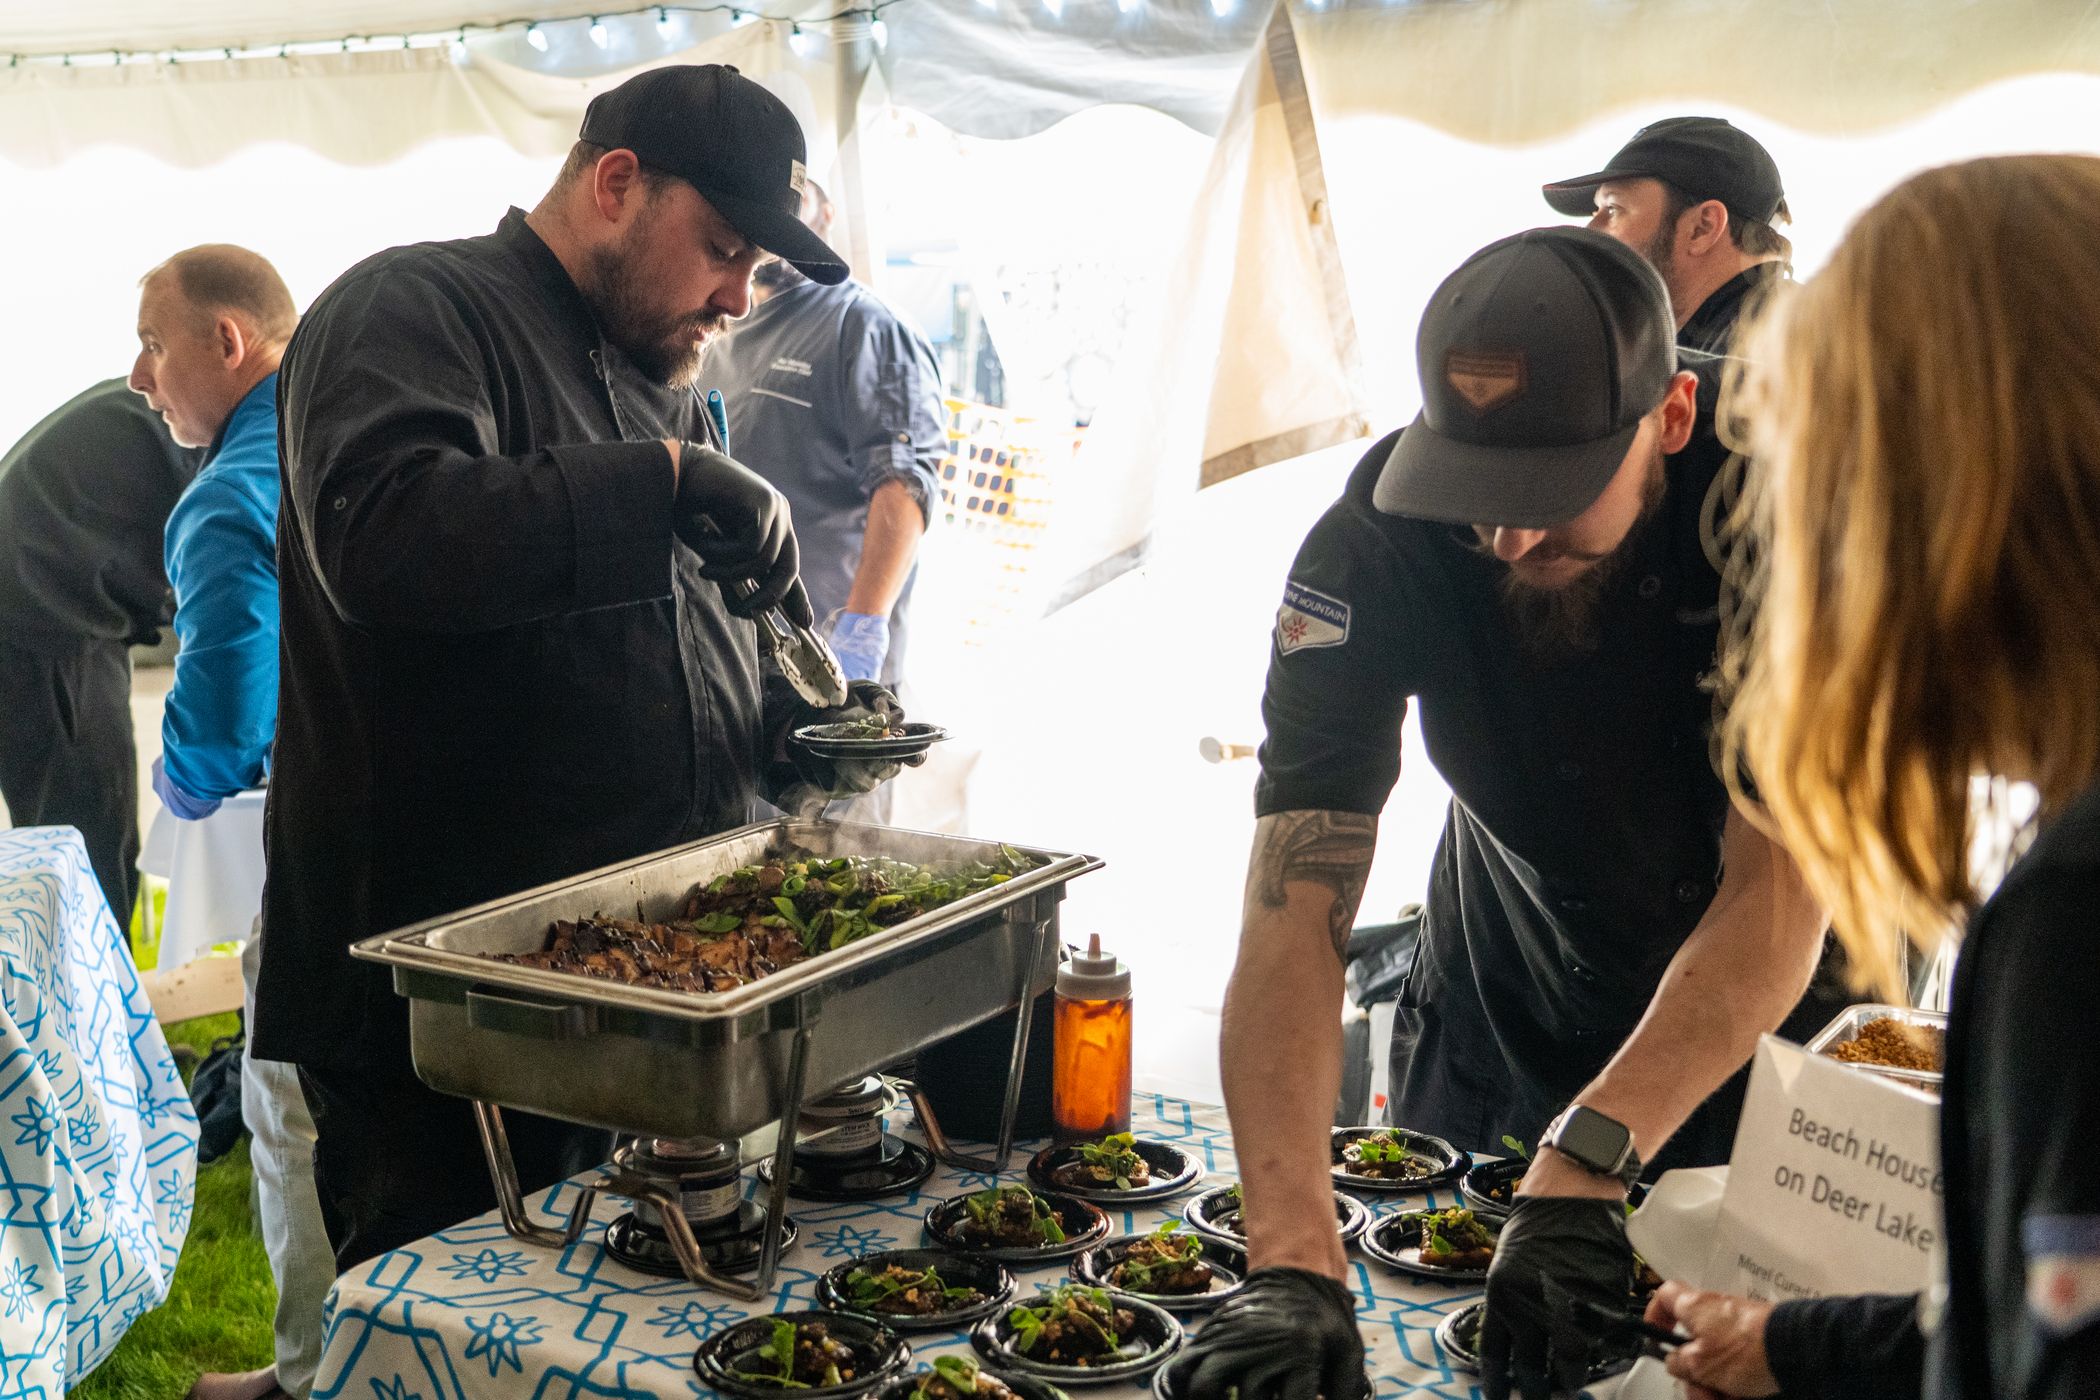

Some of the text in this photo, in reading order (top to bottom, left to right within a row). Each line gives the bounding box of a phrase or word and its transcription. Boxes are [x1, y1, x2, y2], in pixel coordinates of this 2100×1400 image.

[1298, 598, 1346, 622] MOUNTAIN
[1788, 1108, 1860, 1161] Beach
[1774, 1165, 1934, 1252] on Deer Lake
